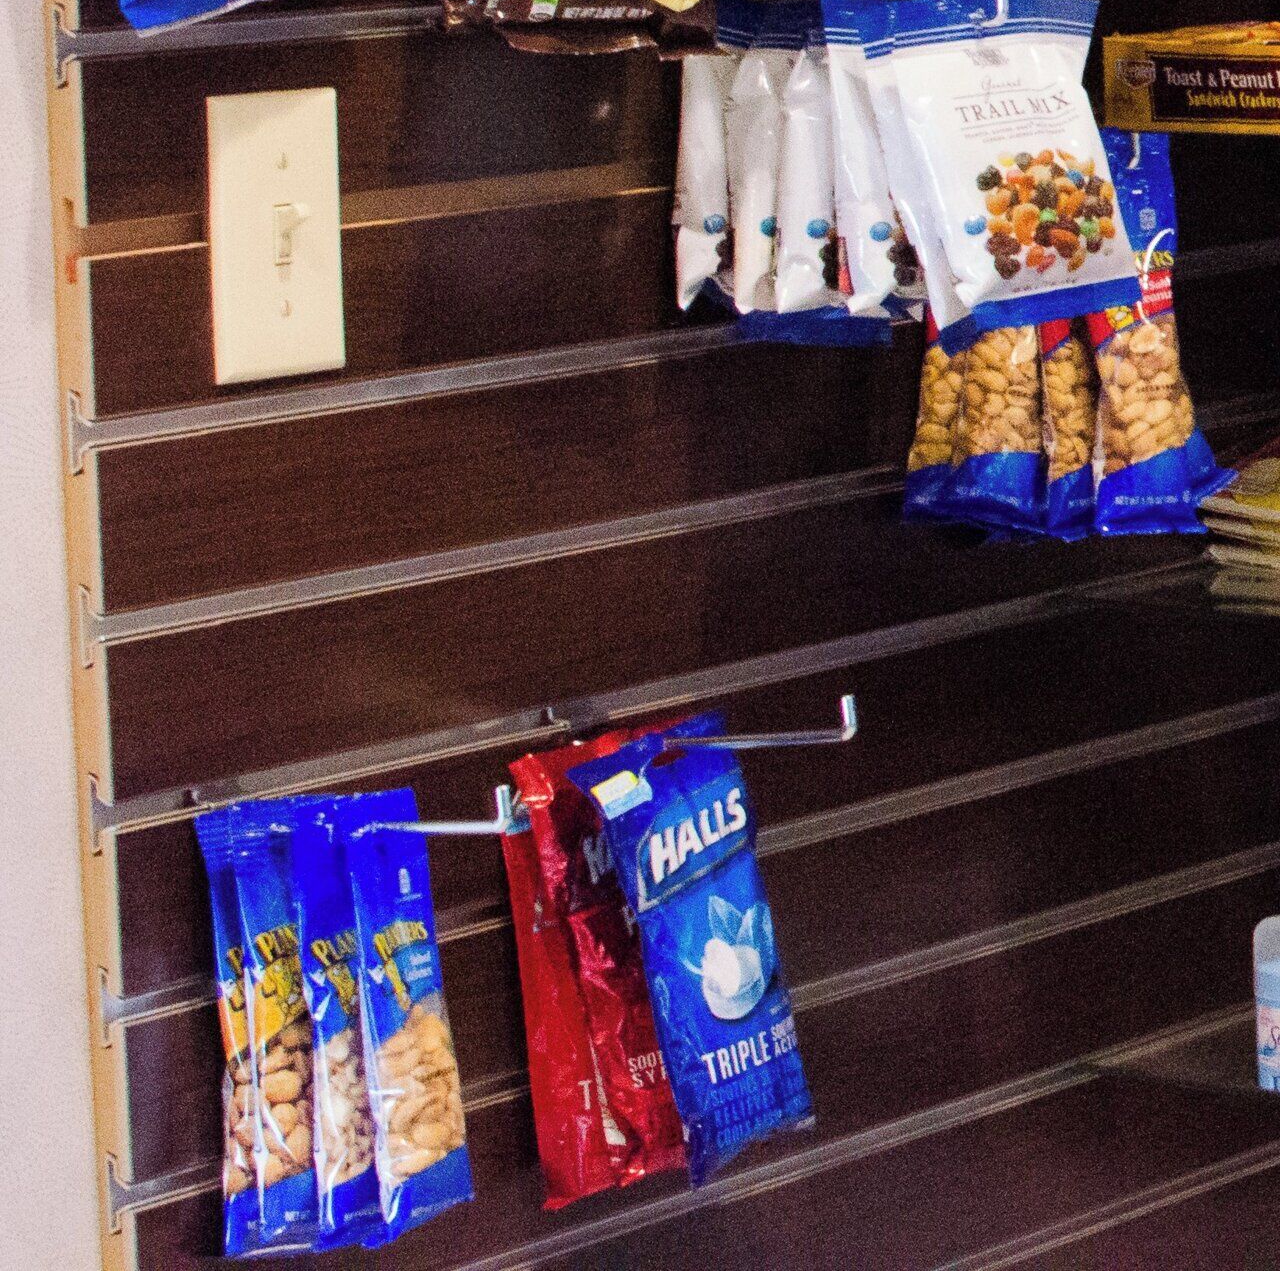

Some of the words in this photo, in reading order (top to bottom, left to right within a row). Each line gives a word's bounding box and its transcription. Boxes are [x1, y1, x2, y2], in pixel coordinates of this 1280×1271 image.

[1163, 67, 1202, 87] Toast
[1208, 74, 1218, 88] &
[1219, 68, 1275, 89] Peanut
[954, 100, 1027, 123] TRAIL
[1027, 90, 1072, 115] MIX
[1187, 90, 1237, 108] Sandwich
[646, 787, 747, 884] HALLS
[701, 1031, 772, 1085] TRIPLE
